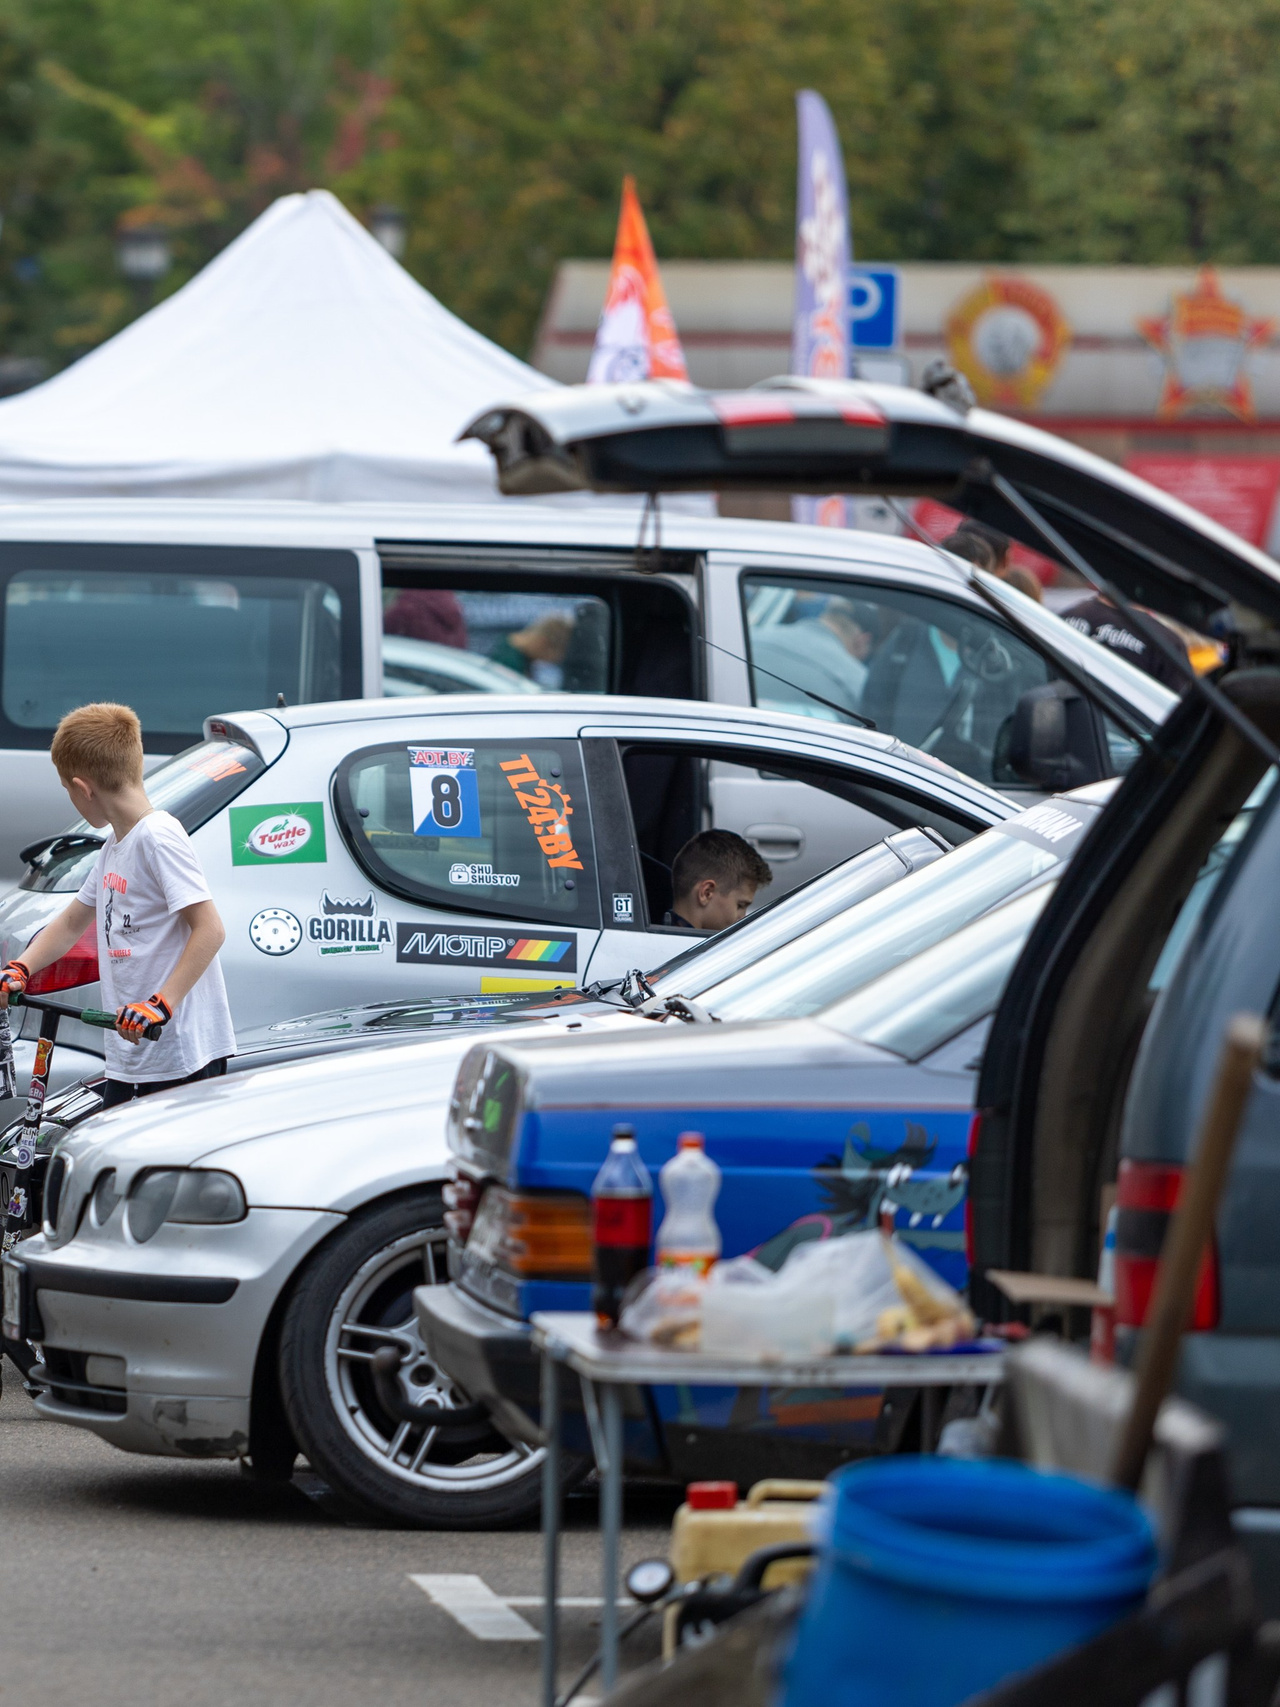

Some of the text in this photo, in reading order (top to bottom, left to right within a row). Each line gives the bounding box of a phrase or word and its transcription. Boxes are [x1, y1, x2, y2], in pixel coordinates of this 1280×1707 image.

[414, 751, 468, 766] ADT.BY
[431, 774, 462, 828] 8
[259, 826, 306, 846] Turtle
[273, 839, 296, 850] wax
[470, 864, 491, 875] SHU
[470, 874, 519, 885] SHUSTOV
[615, 899, 630, 912] GT
[123, 913, 132, 928] 22
[309, 918, 391, 942] GORILLA
